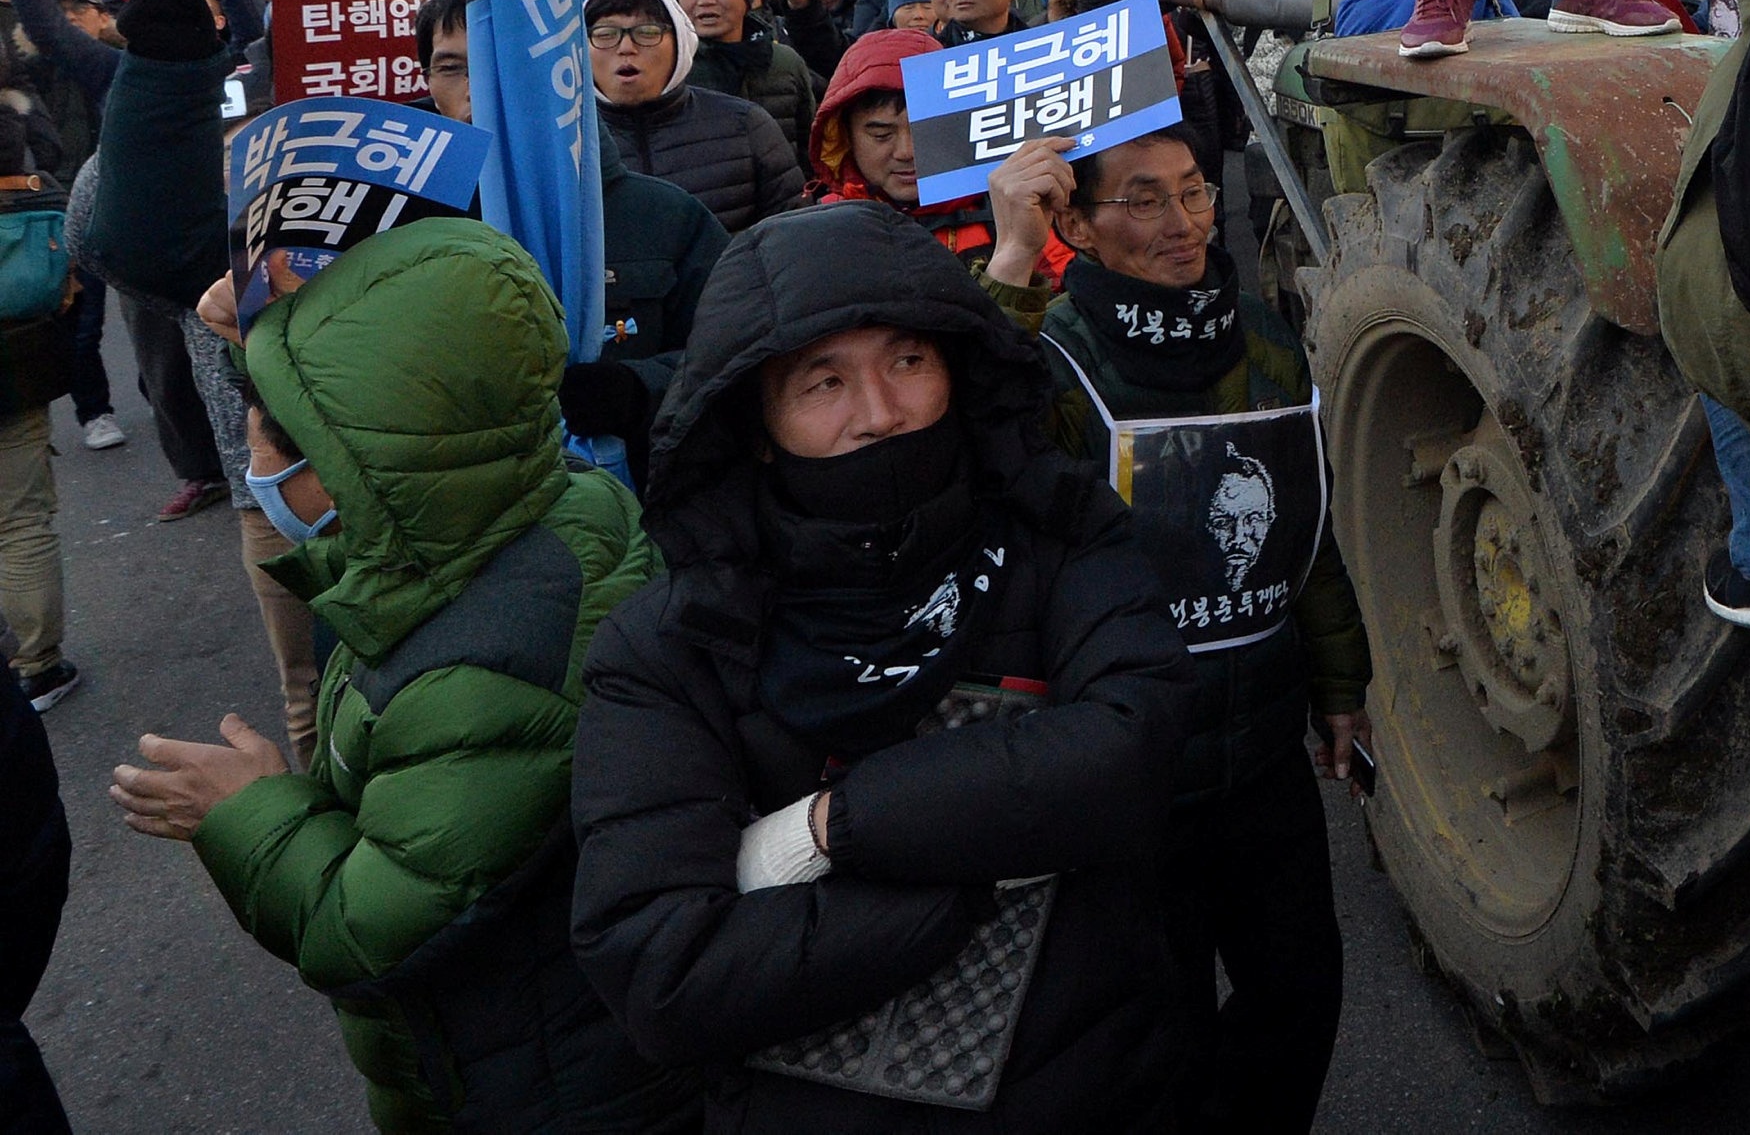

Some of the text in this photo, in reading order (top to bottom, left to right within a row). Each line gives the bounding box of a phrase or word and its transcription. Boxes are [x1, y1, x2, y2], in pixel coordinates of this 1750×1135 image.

[943, 7, 1130, 102] 박근혜
[243, 110, 453, 193] 박근혜
[968, 64, 1124, 161] 탄핵!
